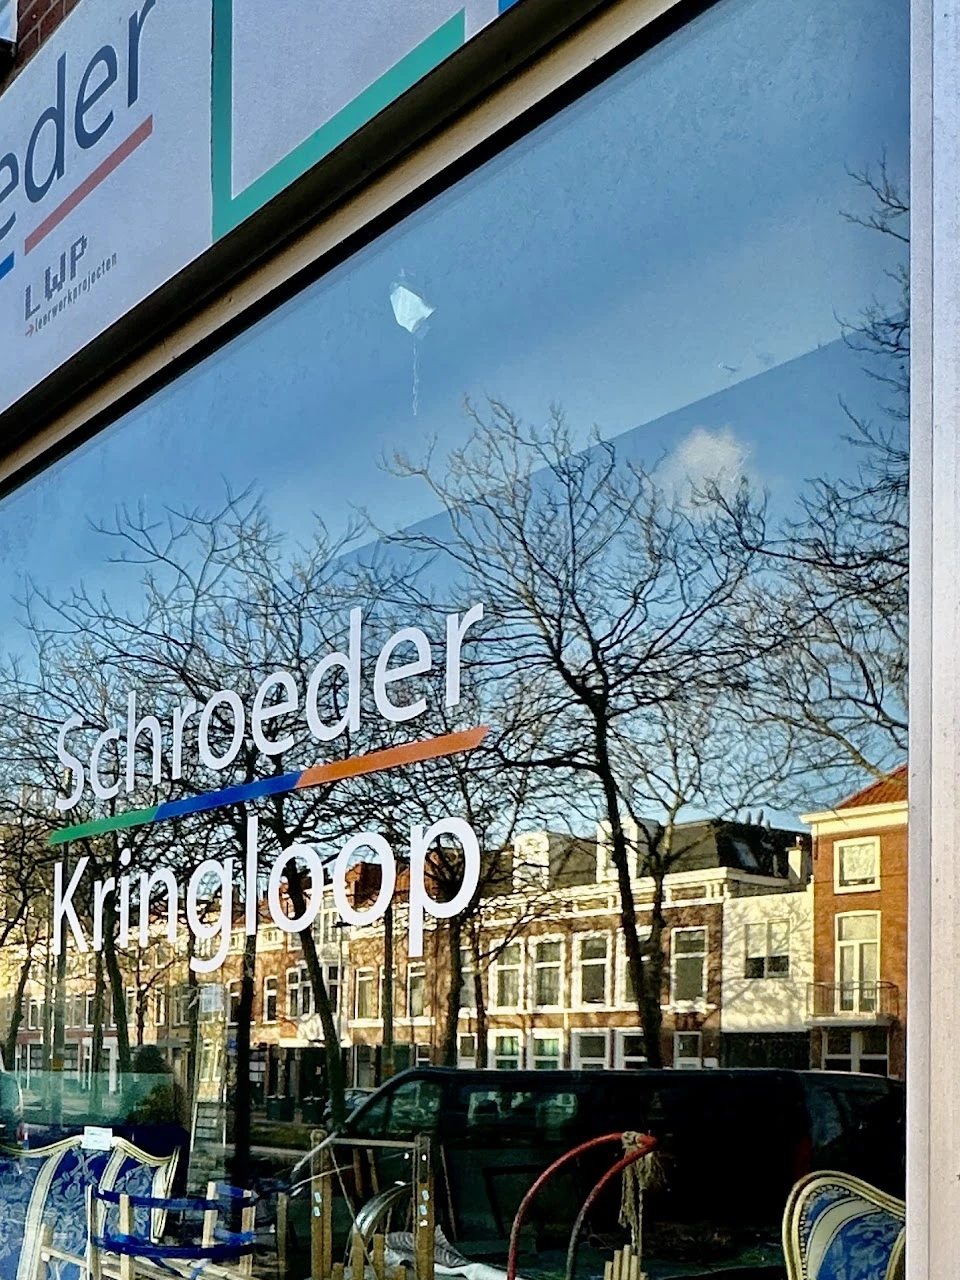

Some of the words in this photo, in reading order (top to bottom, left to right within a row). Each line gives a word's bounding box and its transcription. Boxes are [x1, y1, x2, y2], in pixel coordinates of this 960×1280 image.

[25, 234, 88, 321] LWP
[55, 603, 483, 810] Schroeder
[52, 816, 481, 973] Kringloop
